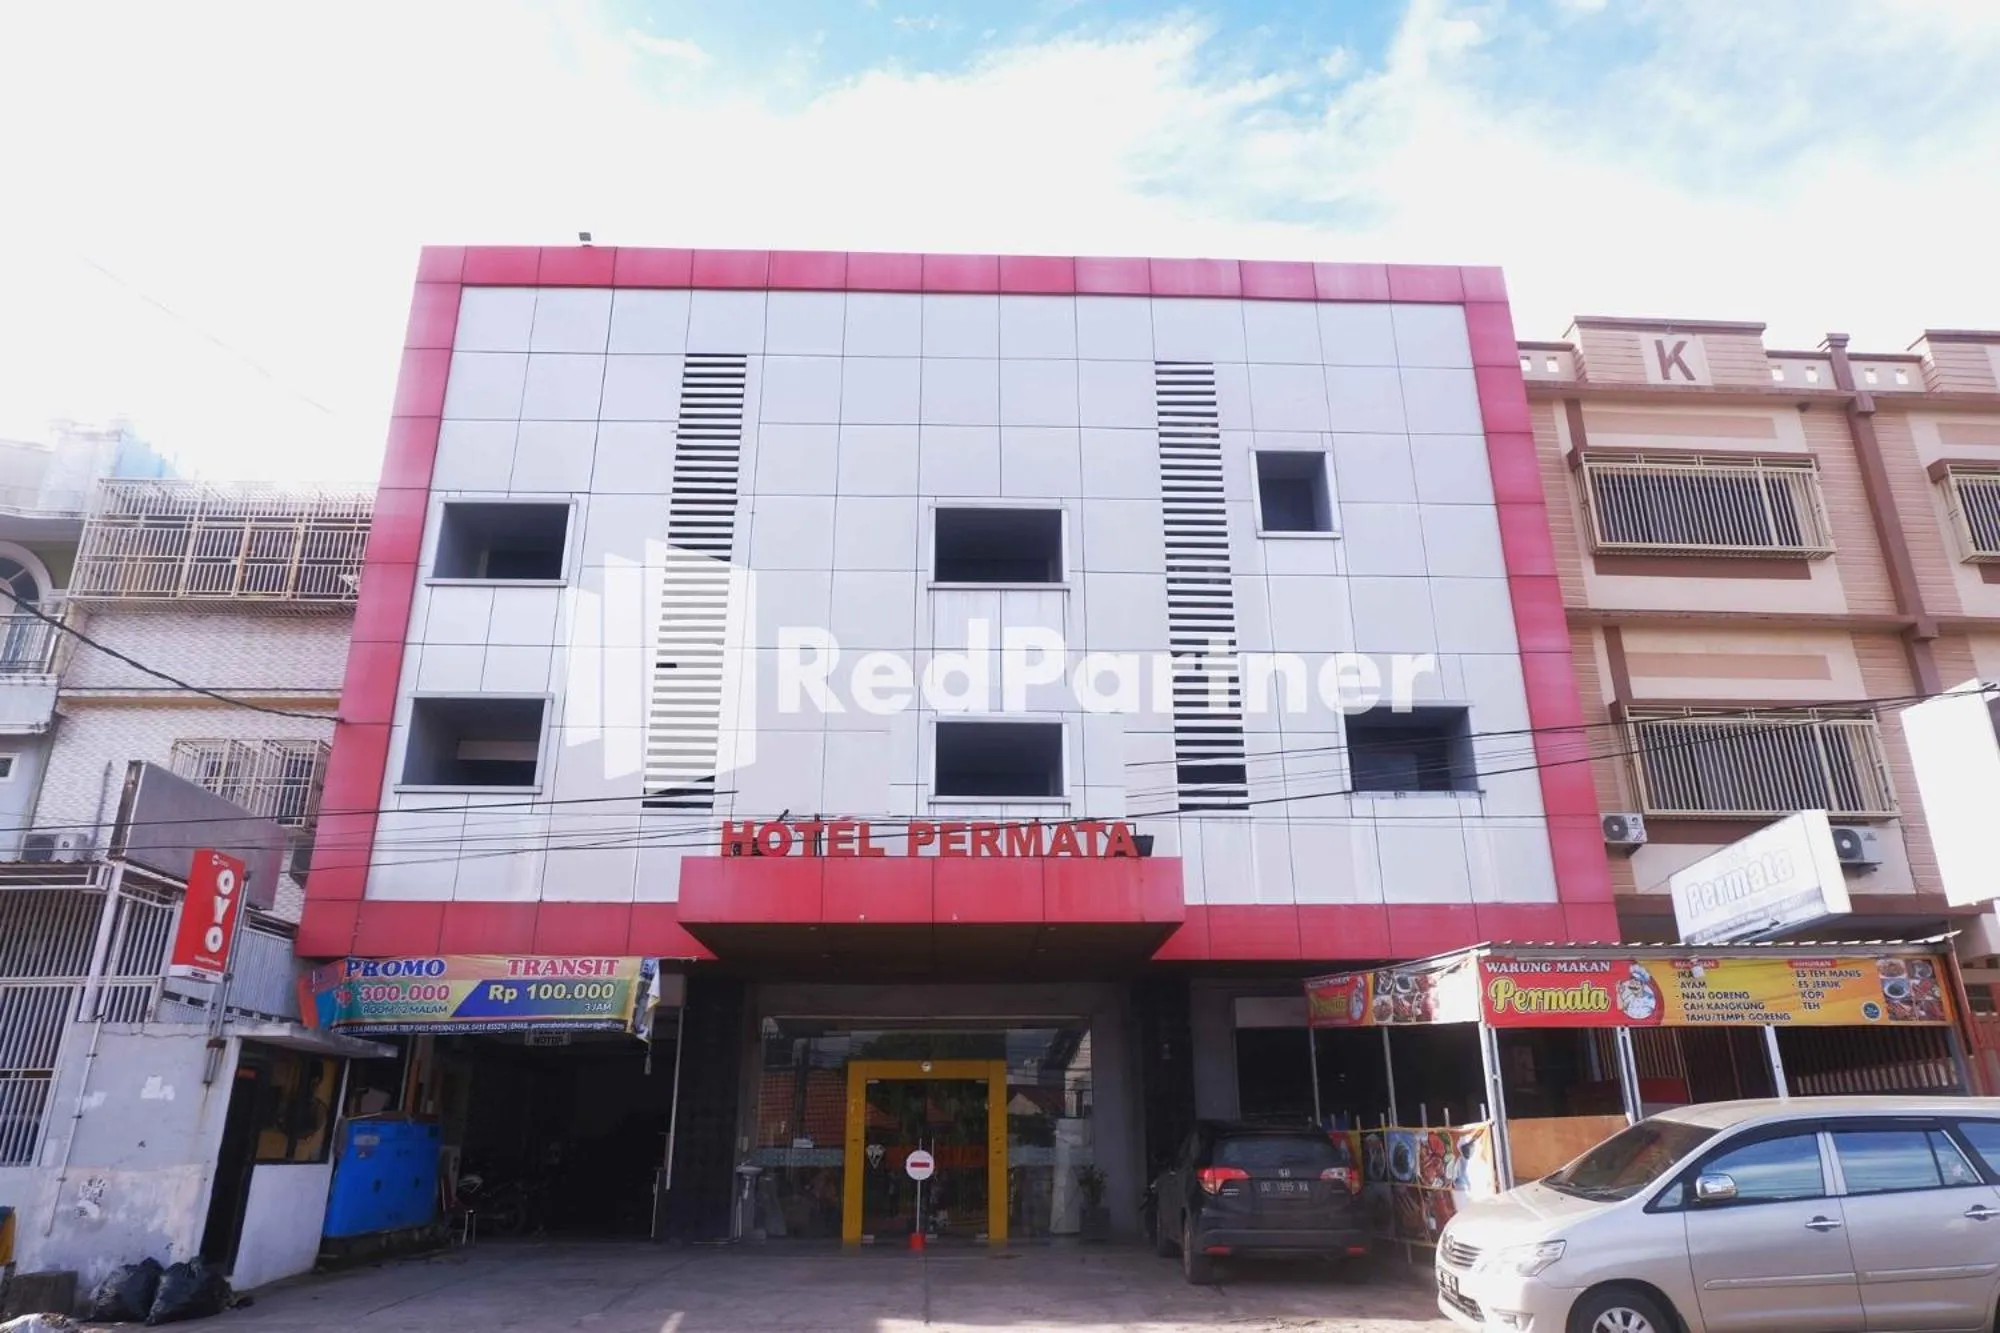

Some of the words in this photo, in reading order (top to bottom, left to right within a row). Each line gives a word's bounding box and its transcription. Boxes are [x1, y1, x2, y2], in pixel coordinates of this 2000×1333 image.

[1654, 339, 1696, 381] K
[721, 820, 885, 857] HOTEL
[907, 820, 1137, 857] PERMATA
[1685, 849, 1795, 918] Permata
[205, 869, 235, 953] OYO
[346, 959, 446, 977] PROMO
[507, 959, 619, 976] TRANSIT
[1486, 961, 1551, 973] WARUNG
[1557, 961, 1610, 972] MAKAN
[1829, 969, 1862, 977] MANIS
[1680, 981, 1706, 989] AYAM
[1812, 980, 1841, 989] JERUK
[359, 984, 450, 1002] 300.000
[488, 984, 518, 1004] Rp
[526, 983, 615, 1000] 100.000
[1489, 976, 1610, 1014] Permata
[1682, 991, 1705, 1000] NASI
[1708, 991, 1750, 1000] GORENG
[1801, 991, 1824, 1000] KOPI
[410, 1004, 448, 1013] MALAM
[1683, 1002, 1704, 1011] CAH
[1706, 1001, 1765, 1011] KANGKUNG
[1748, 1012, 1791, 1021] GORENG
